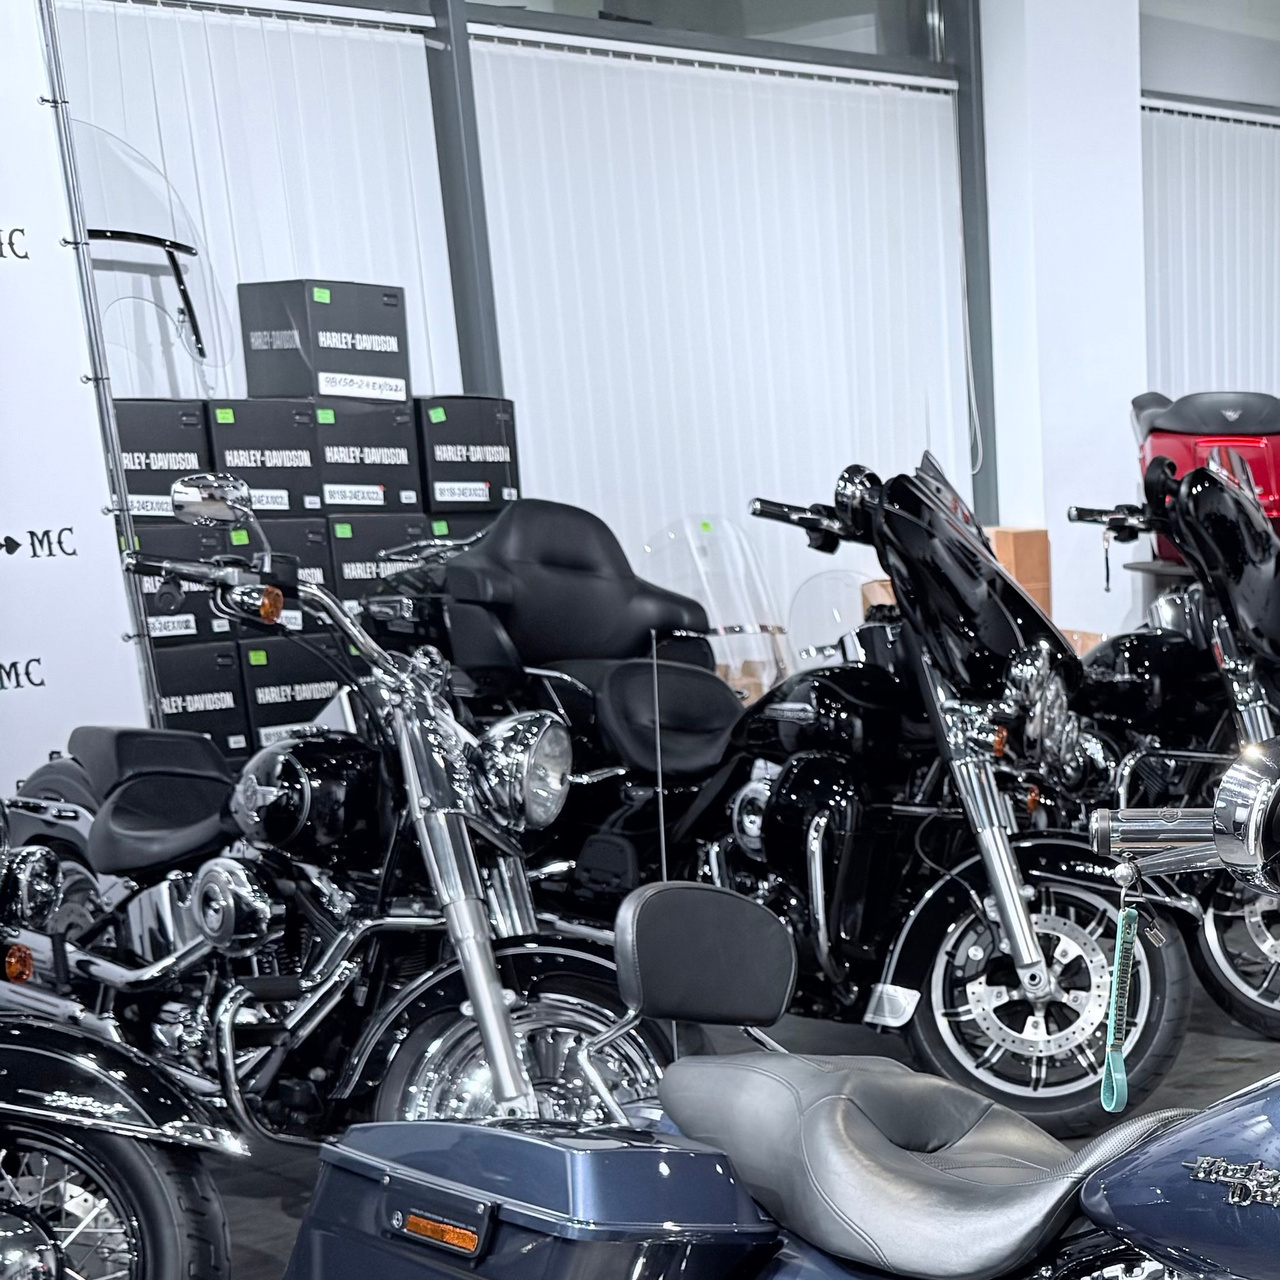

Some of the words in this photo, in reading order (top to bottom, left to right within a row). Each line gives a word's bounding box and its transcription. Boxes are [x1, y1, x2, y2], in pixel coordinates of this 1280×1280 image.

[0, 228, 30, 260] C
[317, 331, 399, 352] HARLEY-DAVIDSON
[122, 452, 200, 470] RLEY-DAVIDSON
[225, 450, 313, 468] HARLEY-DAVIDSON
[324, 446, 410, 465] HARLEY-DAVIDSON
[434, 444, 512, 462] HARLEY-DAVIDSON
[26, 527, 78, 558] MC
[0, 658, 46, 690] MC
[161, 691, 235, 714] RLEY-DAVIDSON
[1118, 946, 1131, 999] DAVIDSON
[1115, 1005, 1125, 1035] HELLO
